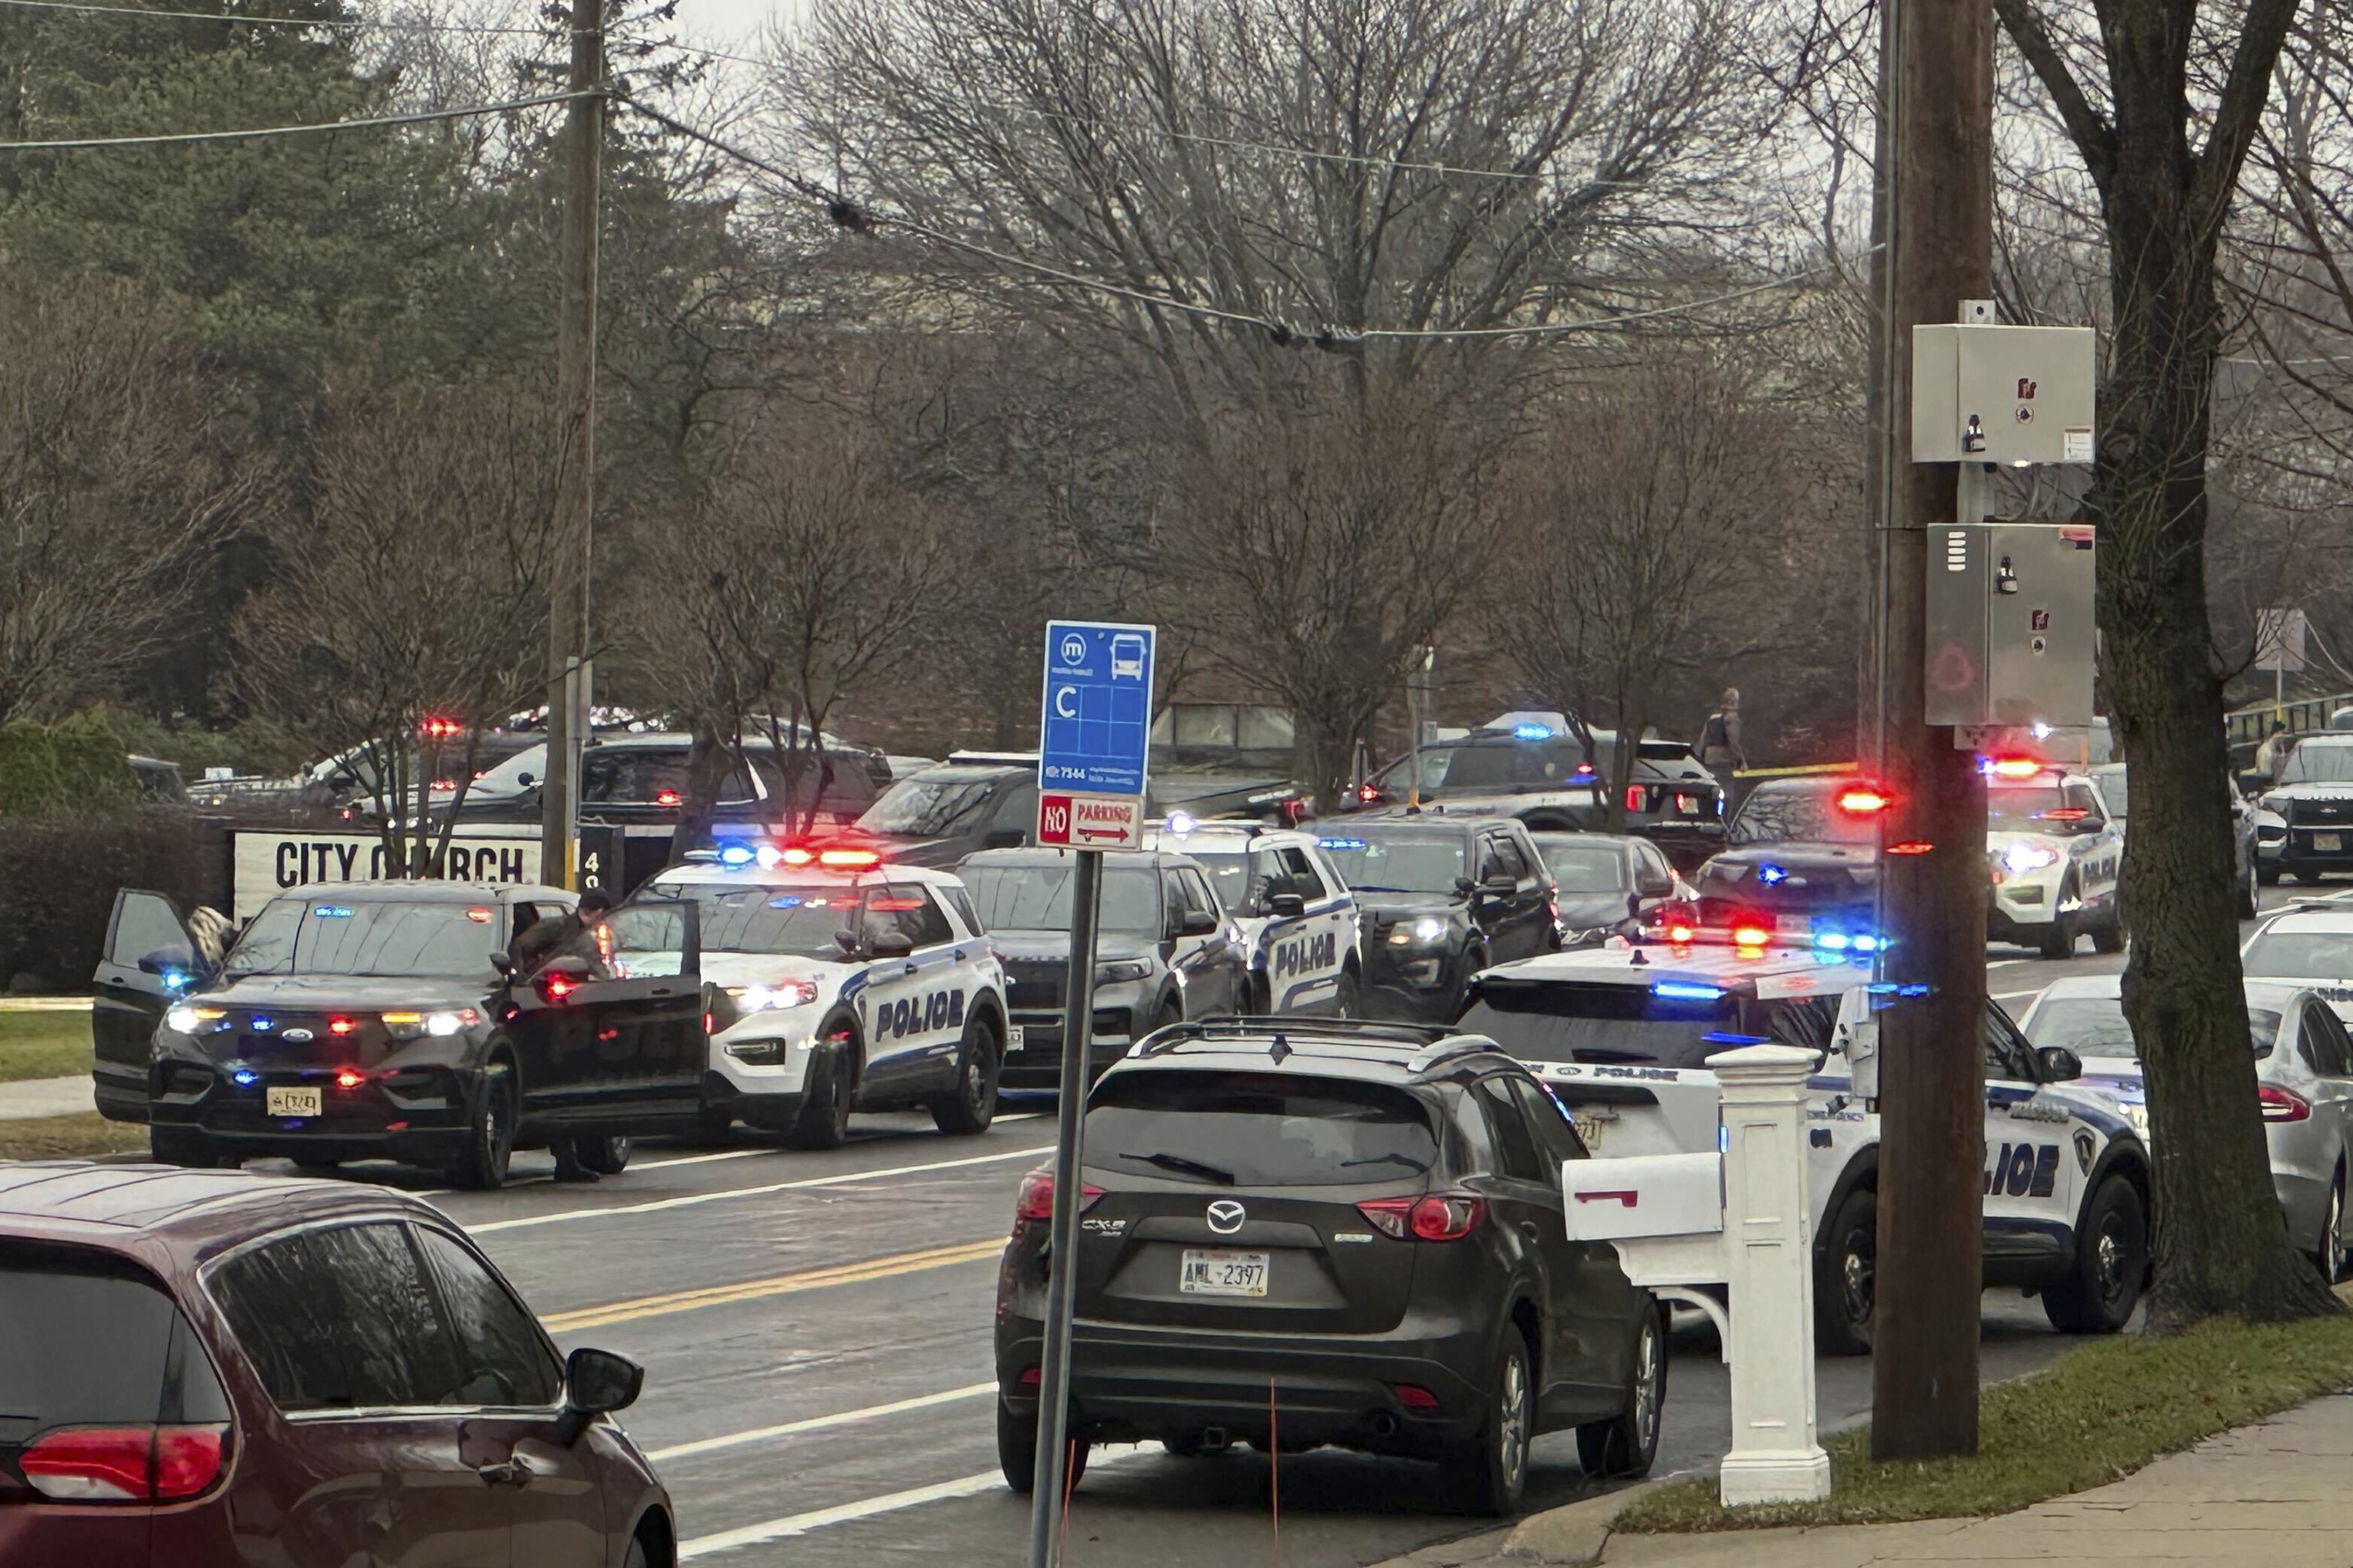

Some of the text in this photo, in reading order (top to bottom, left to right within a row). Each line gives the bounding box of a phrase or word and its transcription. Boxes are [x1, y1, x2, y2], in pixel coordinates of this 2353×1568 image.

[1056, 687, 1076, 718] C
[1045, 804, 1132, 833] NO PARKING
[276, 842, 358, 888] CITY
[1276, 933, 1335, 979] POLICE
[876, 989, 964, 1042] POLICE
[1594, 1066, 1678, 1081] POLICE
